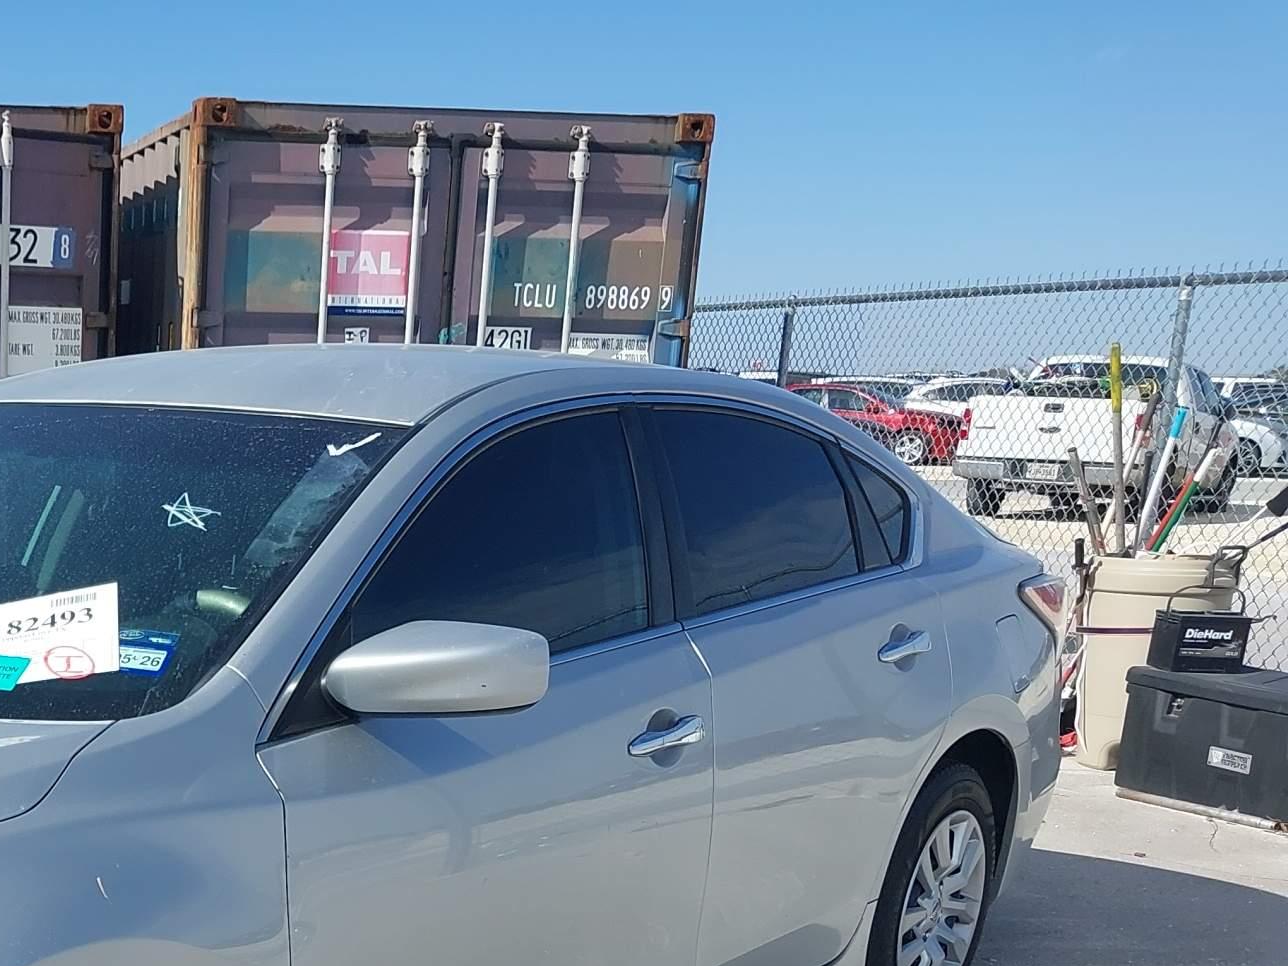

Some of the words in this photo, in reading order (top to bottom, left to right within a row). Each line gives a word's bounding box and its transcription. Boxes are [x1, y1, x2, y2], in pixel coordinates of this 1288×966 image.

[330, 250, 402, 275] TAL
[513, 283, 557, 308] TCLU
[585, 285, 651, 310] 898869
[660, 287, 672, 310] 9
[484, 329, 530, 350] 42G1
[1184, 628, 1234, 641] DieHard
